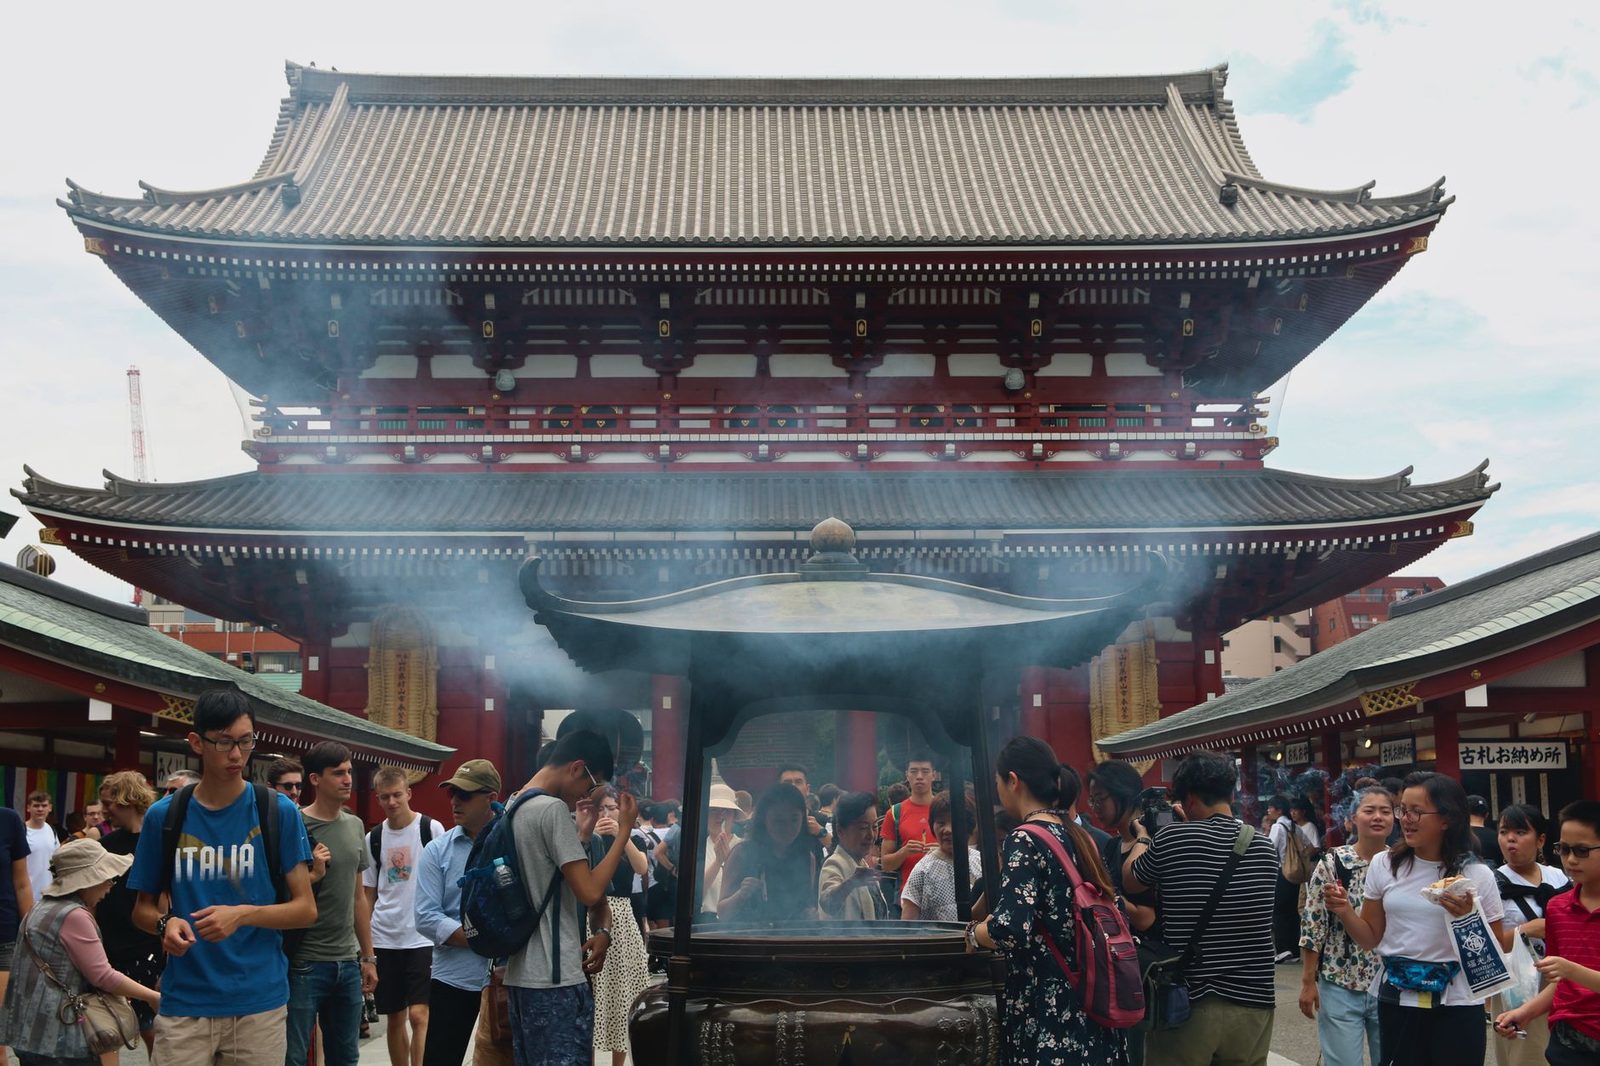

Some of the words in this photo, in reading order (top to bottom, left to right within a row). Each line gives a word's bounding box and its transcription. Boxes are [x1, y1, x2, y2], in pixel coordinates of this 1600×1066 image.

[1460, 745, 1561, 765] 古札お納め所
[175, 843, 255, 883] ITALIA
